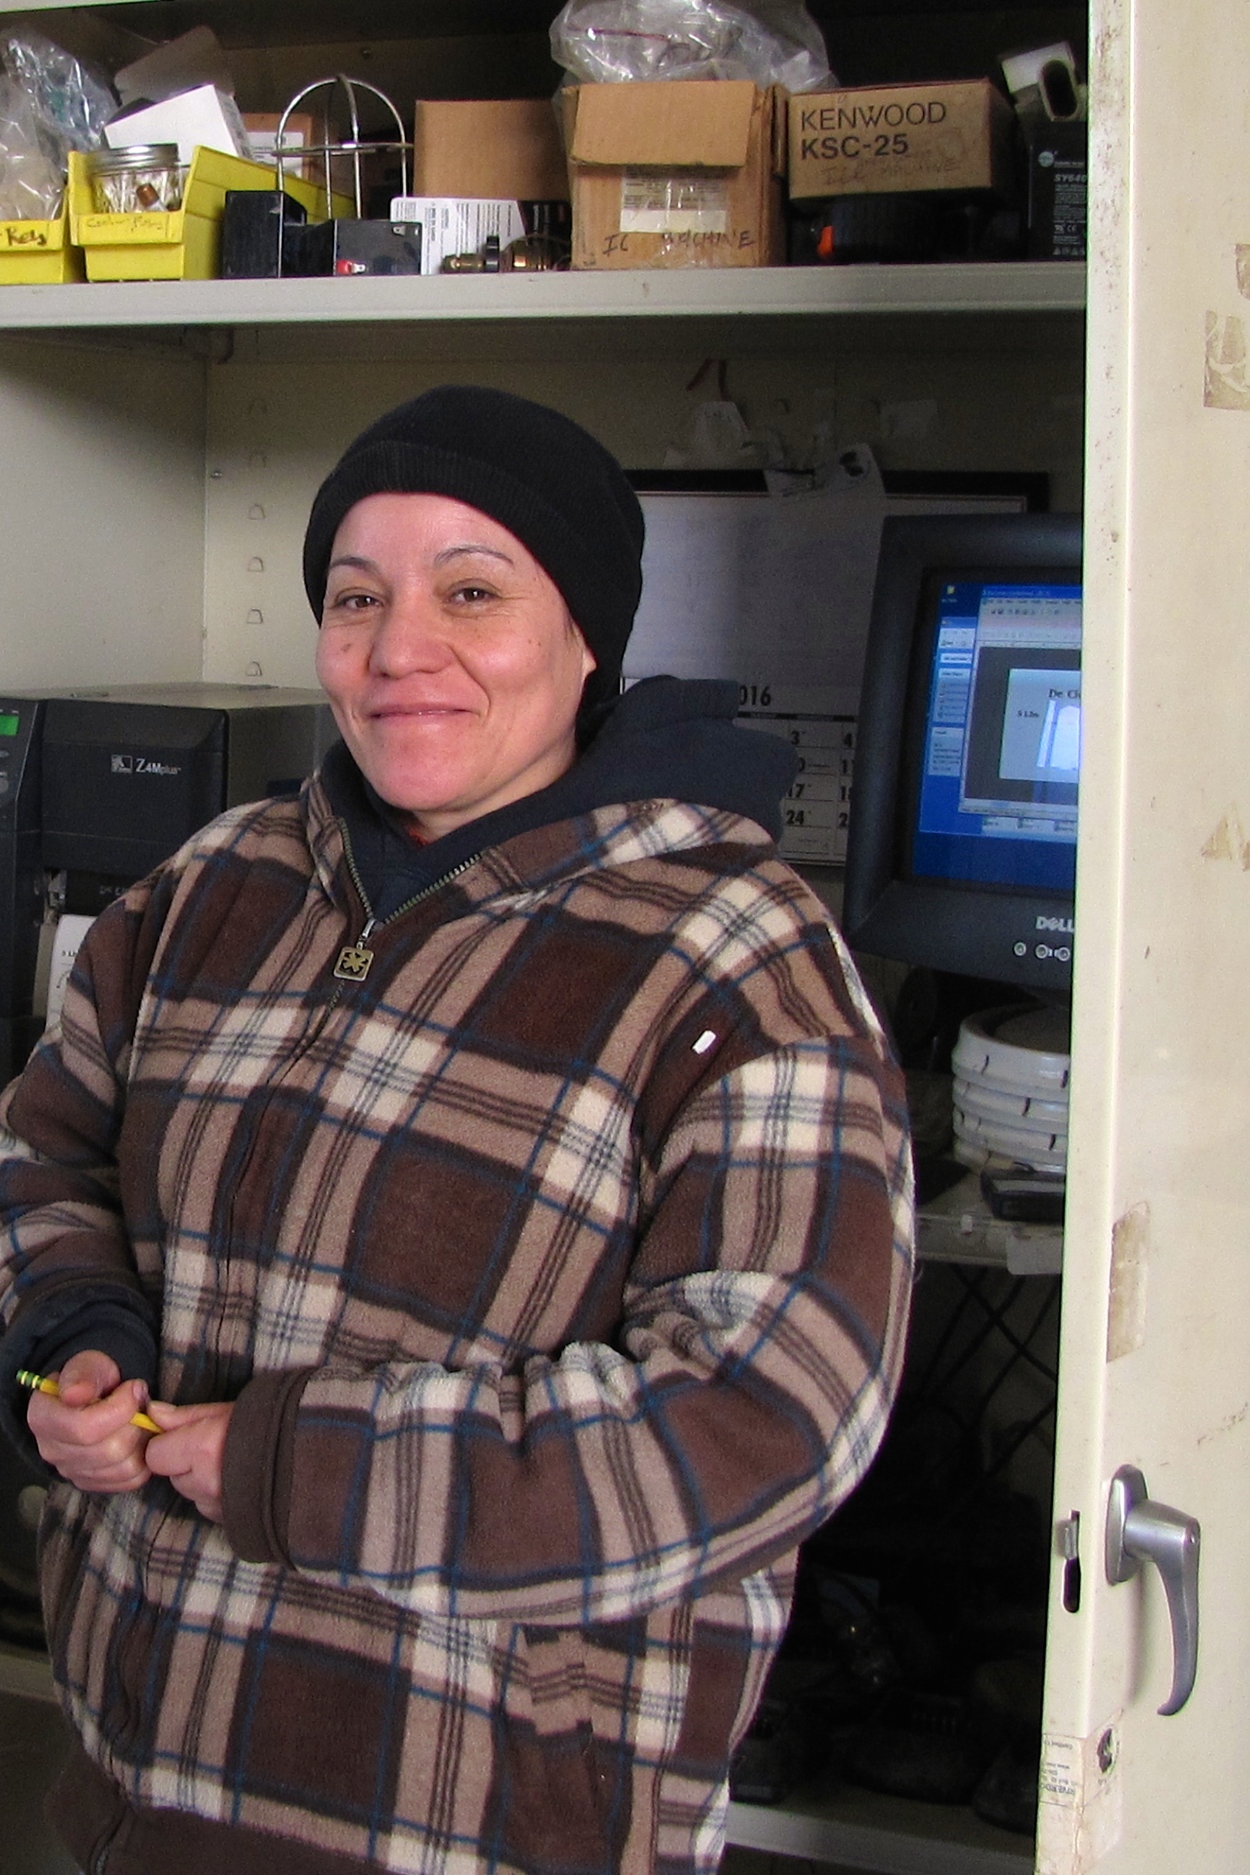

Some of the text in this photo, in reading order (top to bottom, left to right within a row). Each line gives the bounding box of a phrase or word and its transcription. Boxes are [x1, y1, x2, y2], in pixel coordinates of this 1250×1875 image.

[801, 101, 947, 132] KENWOOD
[801, 133, 909, 161] KSC-25
[739, 685, 771, 706] 016
[791, 730, 800, 745] 3
[786, 809, 805, 825] 24
[1035, 916, 1074, 933] DELL
